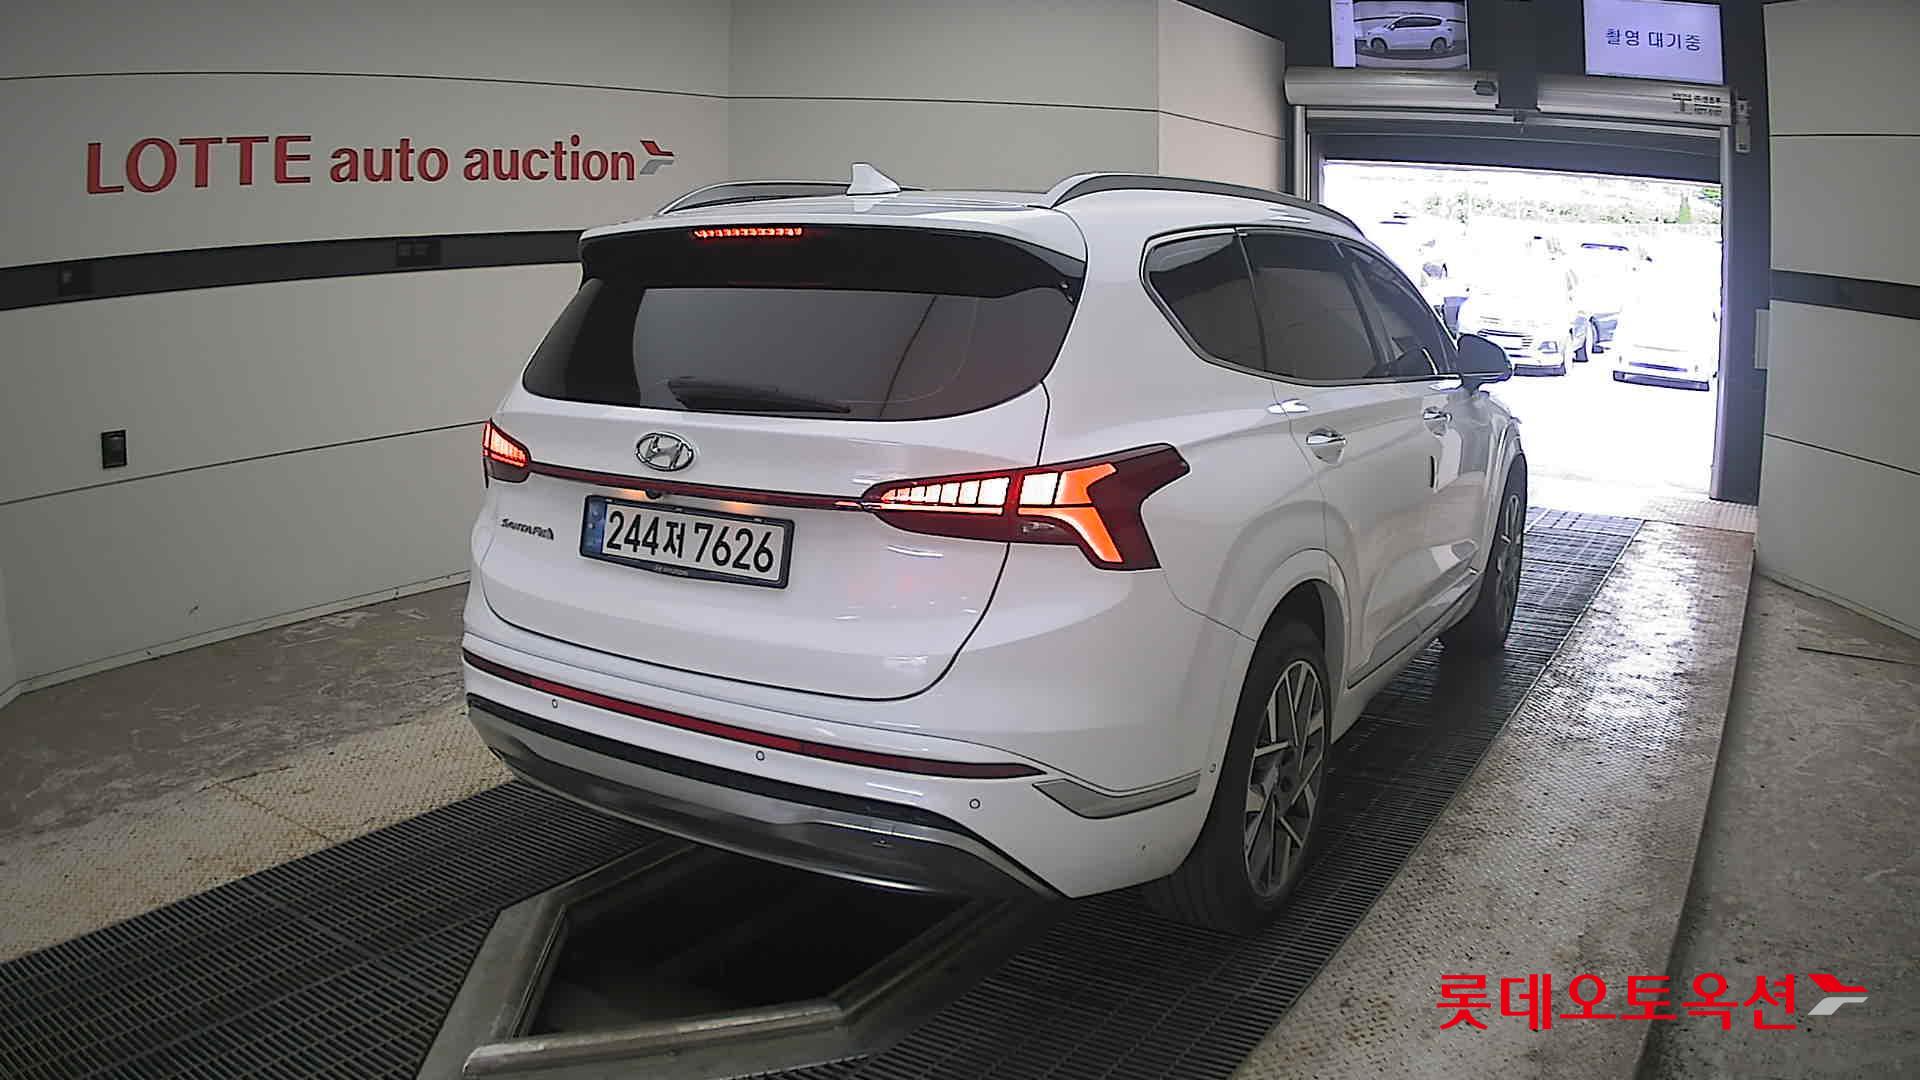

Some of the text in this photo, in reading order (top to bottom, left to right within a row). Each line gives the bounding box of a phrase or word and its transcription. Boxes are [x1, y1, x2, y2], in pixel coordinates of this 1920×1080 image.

[1647, 31, 1701, 52] 대기중
[88, 135, 636, 194] LOTTE auto auction
[606, 510, 774, 573] 244저 7626
